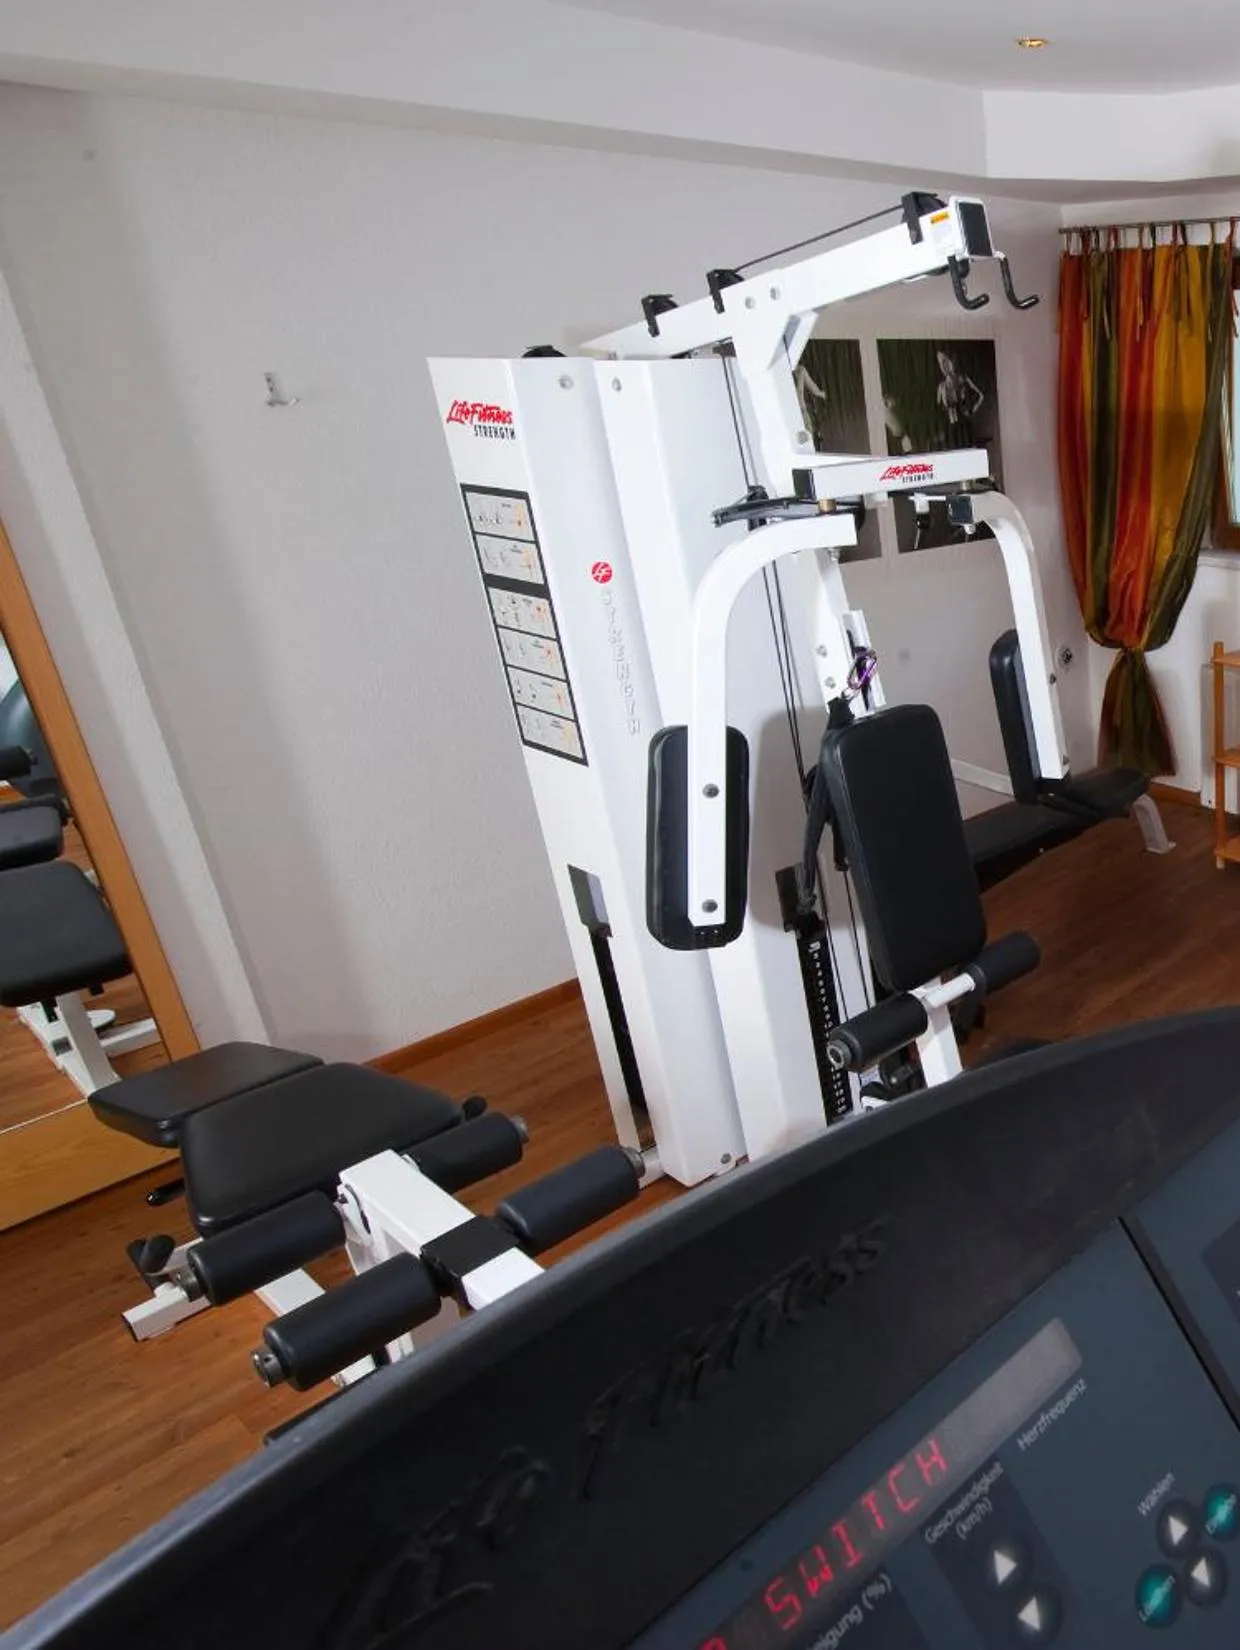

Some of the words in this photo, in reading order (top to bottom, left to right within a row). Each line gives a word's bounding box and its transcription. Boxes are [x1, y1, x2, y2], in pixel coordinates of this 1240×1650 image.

[474, 424, 516, 440] STRENGTH
[1016, 1377, 1088, 1451] Herzfrequenz
[763, 1436, 949, 1631] SWITCH
